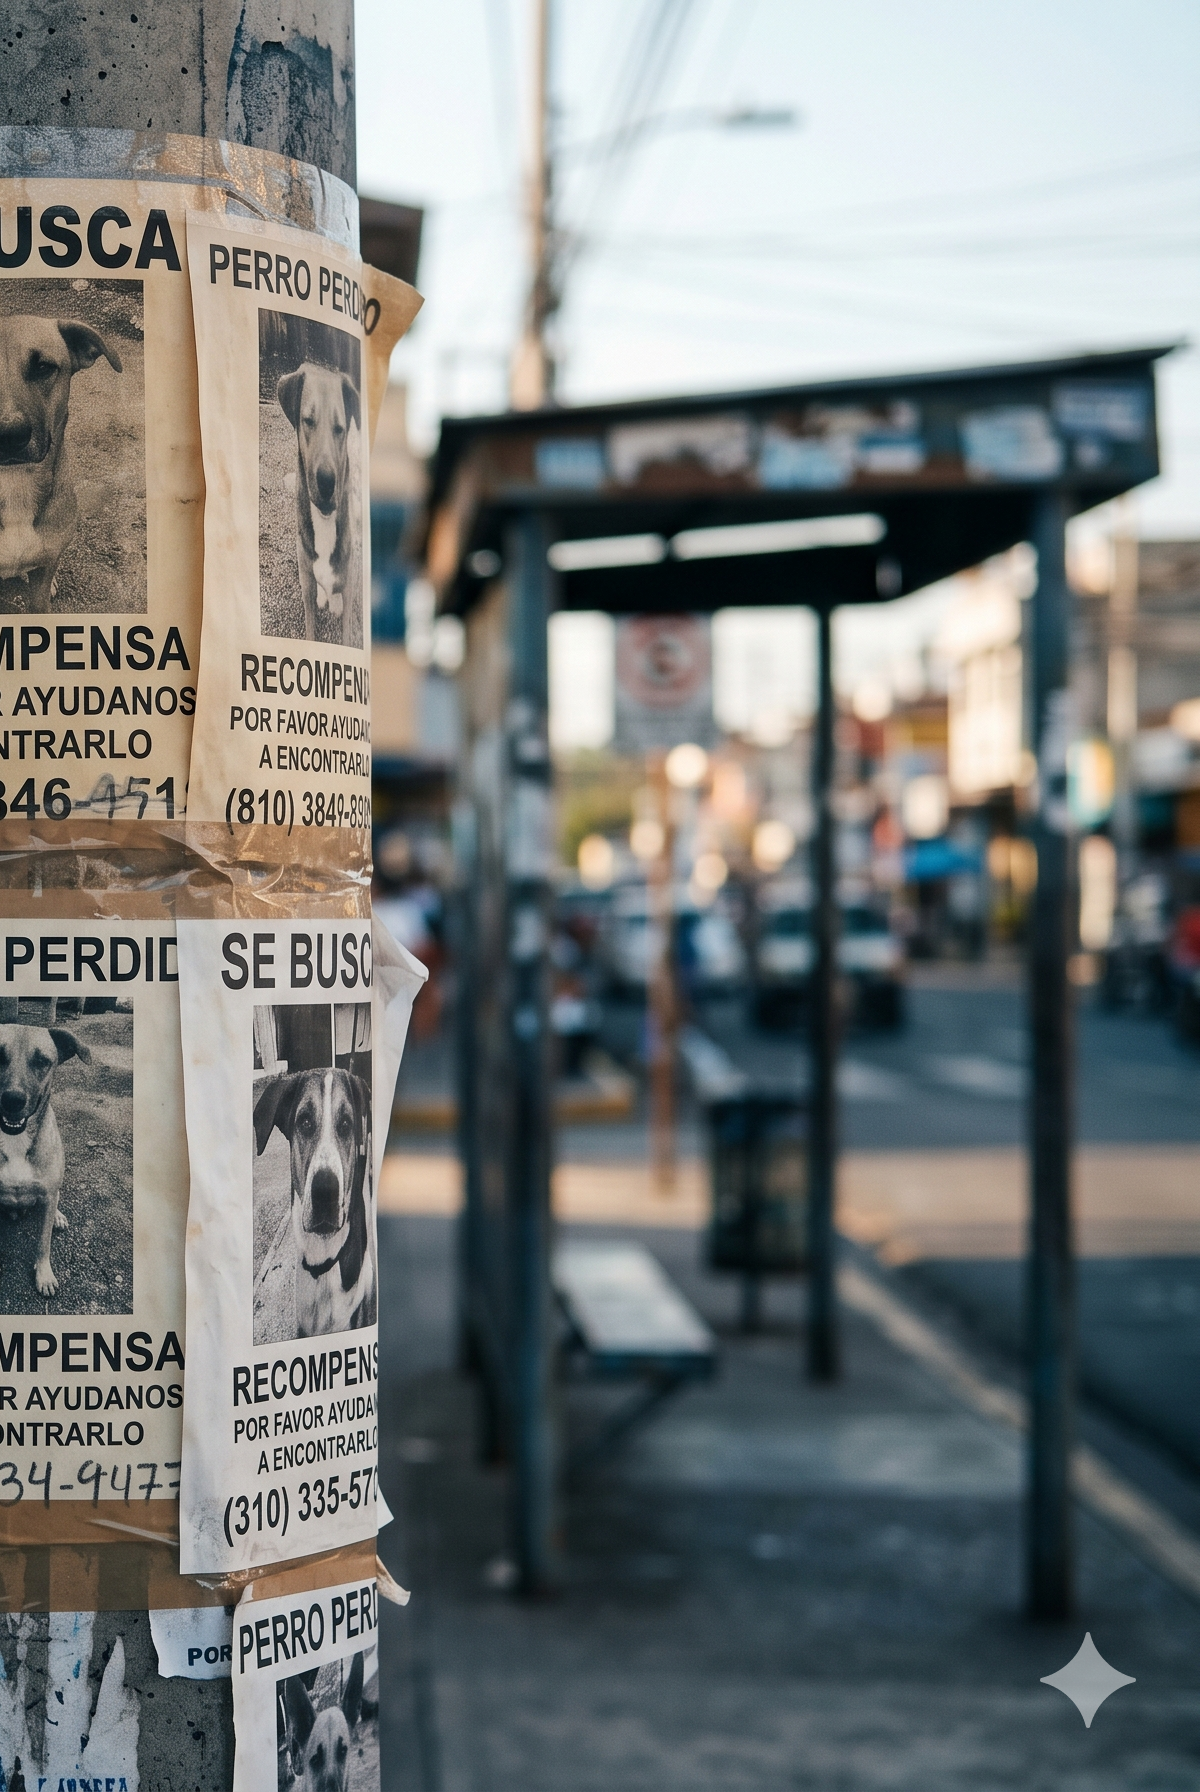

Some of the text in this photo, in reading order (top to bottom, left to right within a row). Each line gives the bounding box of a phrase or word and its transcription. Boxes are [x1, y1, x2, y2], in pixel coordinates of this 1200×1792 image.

[209, 243, 312, 301] PERRO
[11, 685, 197, 717] AYUDANOS
[230, 705, 272, 734] POR
[277, 708, 329, 739] FAVOR
[259, 744, 273, 769] A
[225, 787, 295, 837] (810)
[5, 936, 179, 982] PERDID
[221, 932, 276, 990] SE
[24, 1384, 184, 1411] AYUDANOS
[234, 1414, 270, 1444] POR
[274, 1404, 325, 1437] FAVOR
[257, 1450, 270, 1475] A
[223, 1486, 290, 1548] (310)
[188, 1644, 232, 1666] POR
[240, 1603, 325, 1675] PERRO
